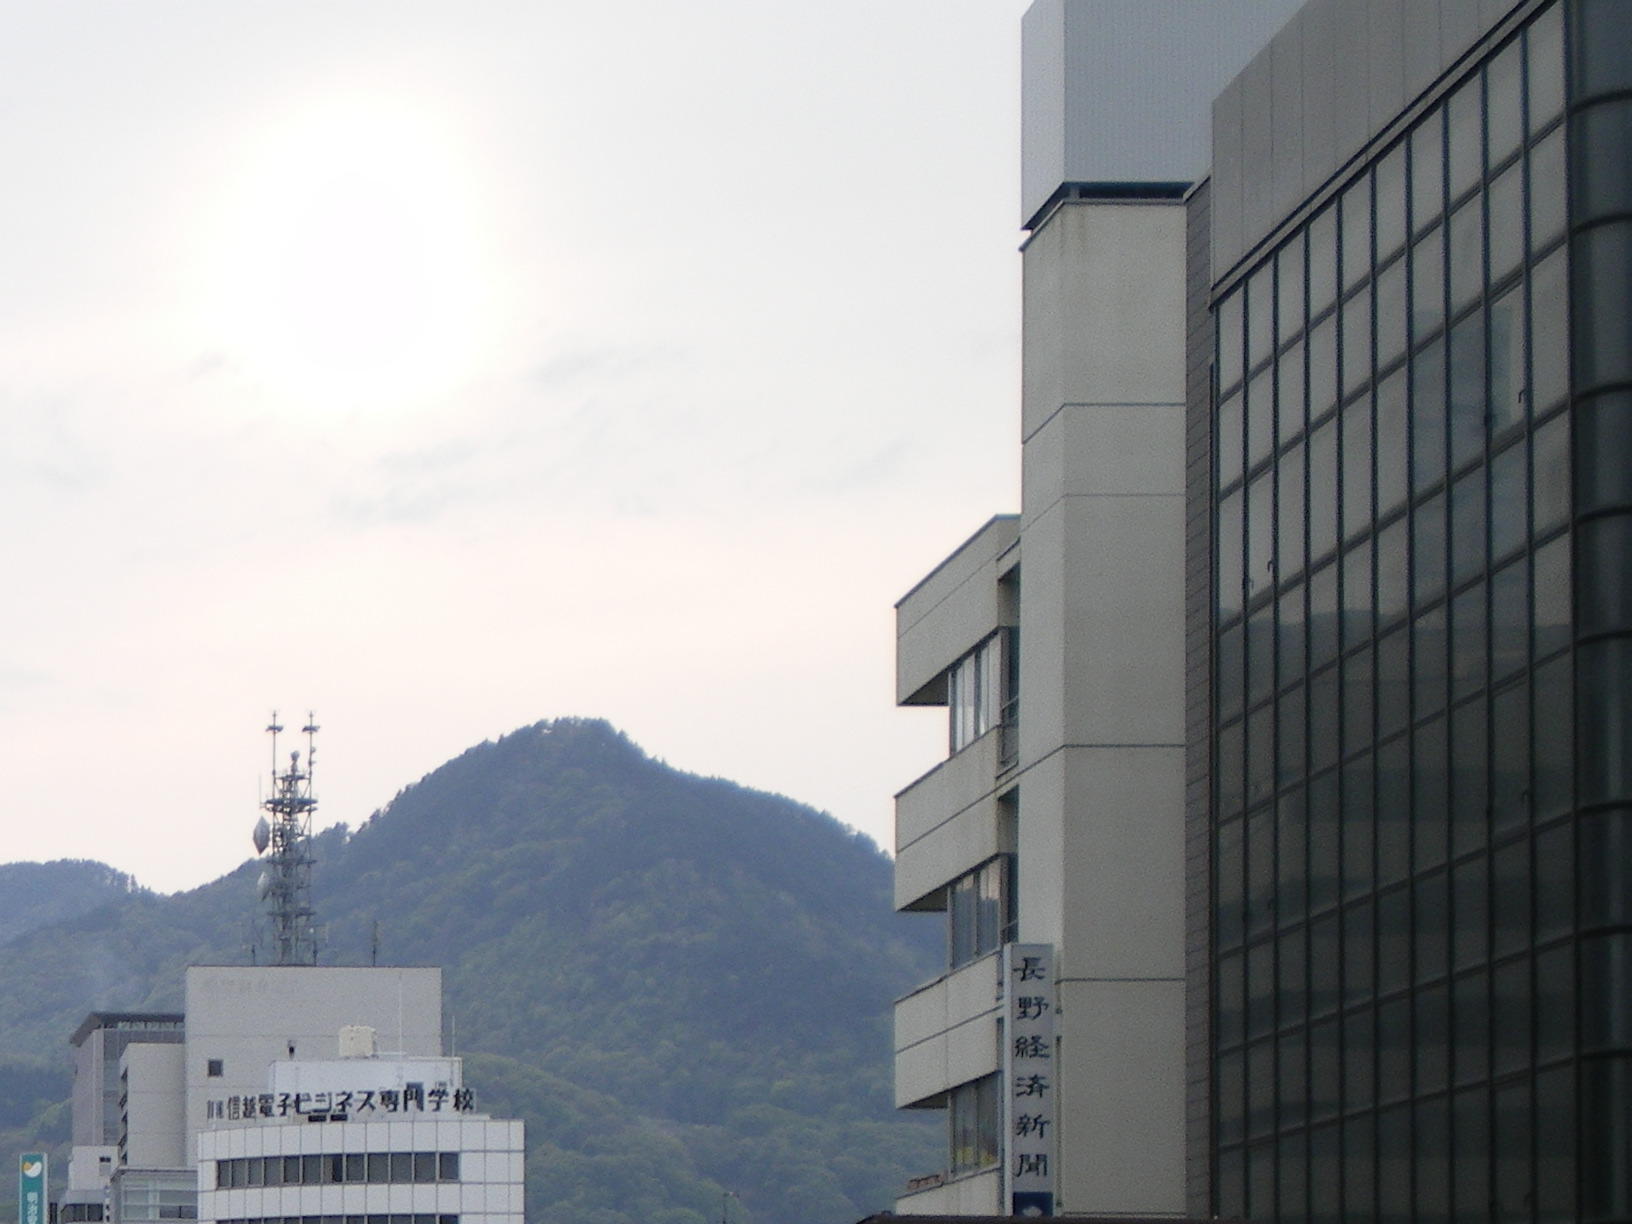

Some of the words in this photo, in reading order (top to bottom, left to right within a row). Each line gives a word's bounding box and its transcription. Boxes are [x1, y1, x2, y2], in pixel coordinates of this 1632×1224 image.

[1013, 956, 1050, 1178] 長野経済新聞
